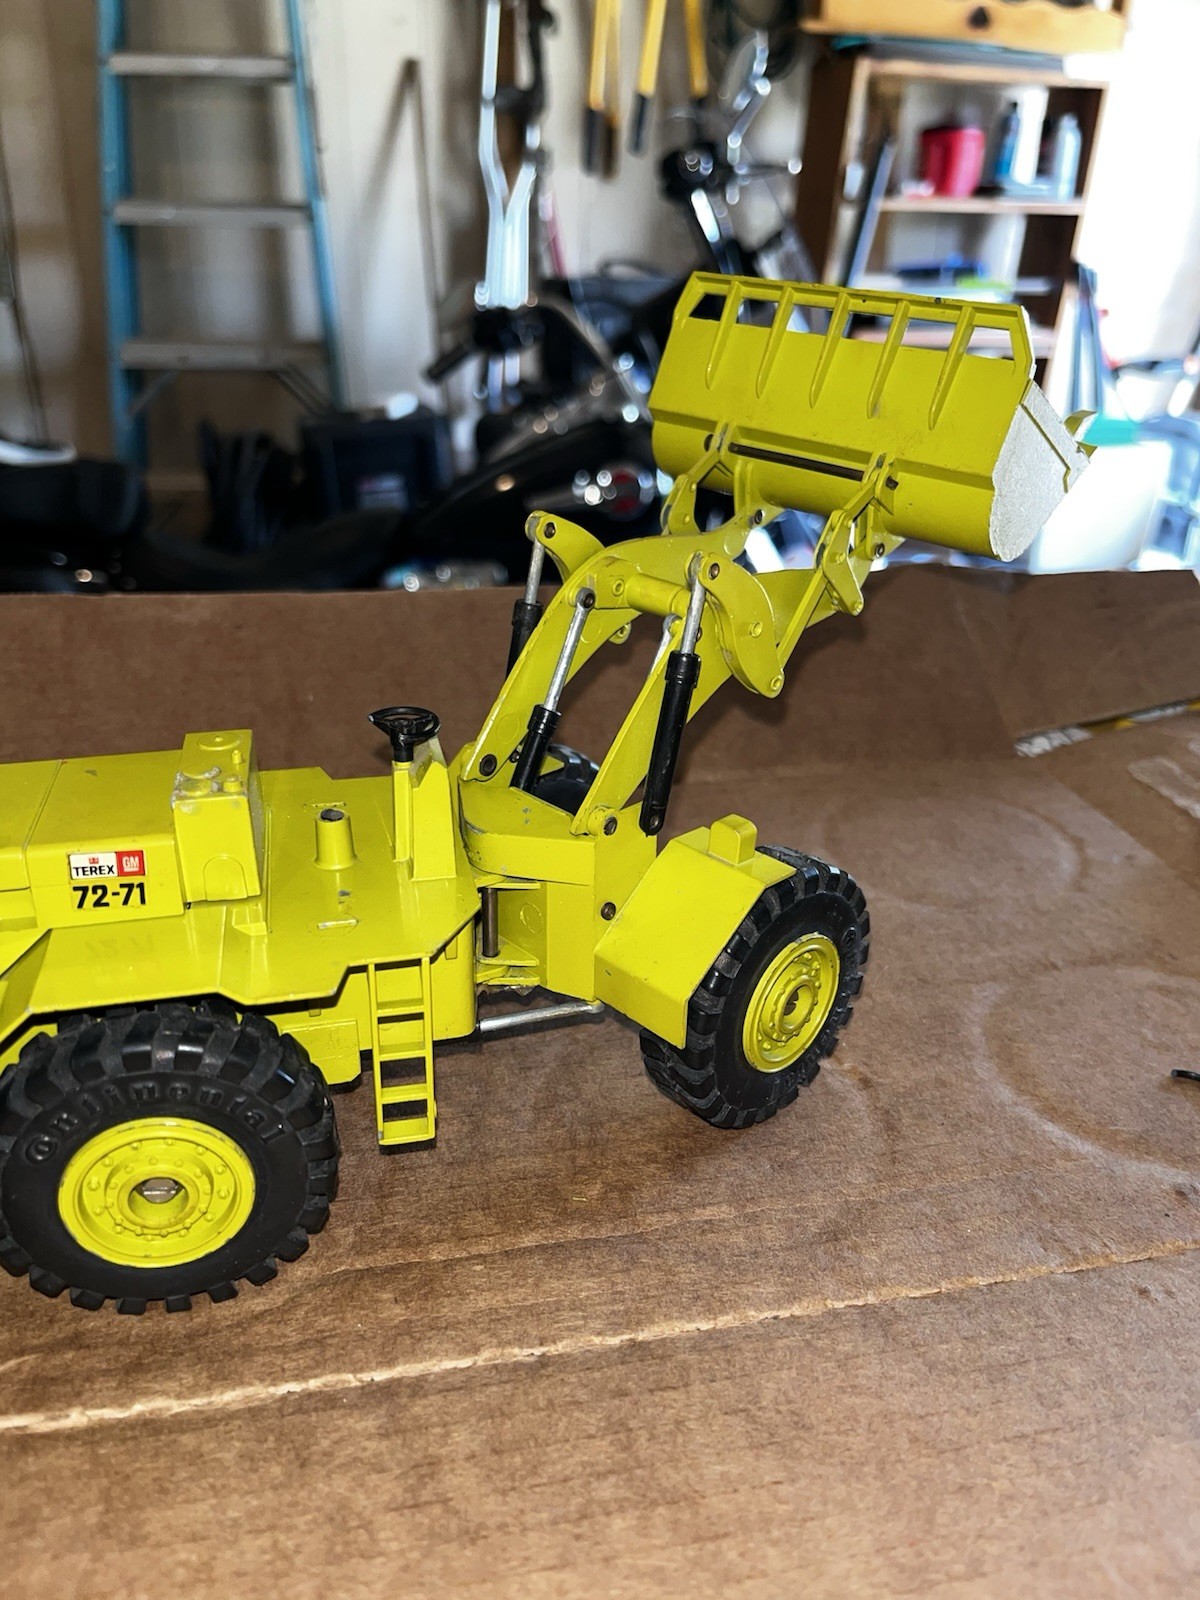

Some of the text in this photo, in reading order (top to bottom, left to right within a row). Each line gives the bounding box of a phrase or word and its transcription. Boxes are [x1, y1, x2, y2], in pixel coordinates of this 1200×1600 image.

[122, 856, 140, 869] GM
[72, 864, 115, 877] TEREX
[72, 882, 146, 909] 72-71
